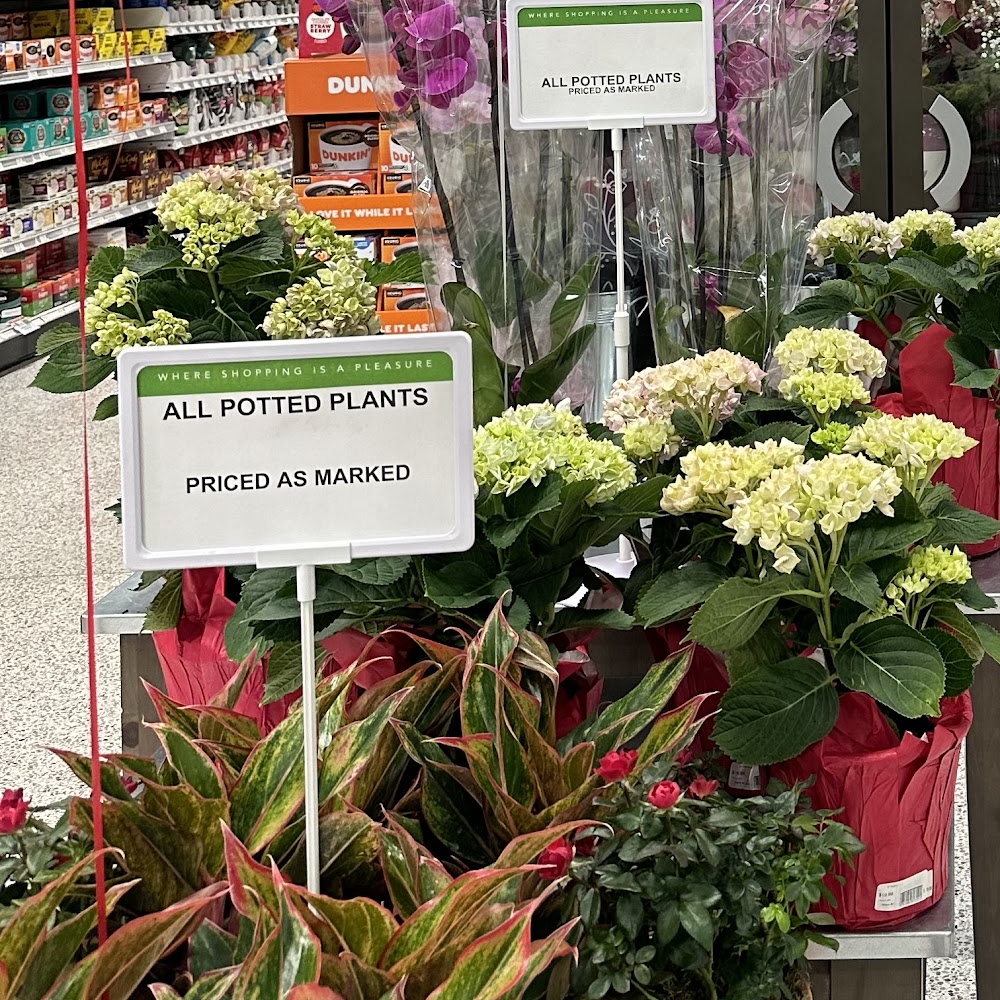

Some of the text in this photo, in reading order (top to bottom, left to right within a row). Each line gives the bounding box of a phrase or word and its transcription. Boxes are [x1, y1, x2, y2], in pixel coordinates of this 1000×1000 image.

[528, 11, 560, 19] WHERE
[565, 10, 614, 18] SHOPPING
[643, 7, 690, 15] PLEASURE
[327, 75, 375, 94] DUN
[541, 72, 681, 88] ALL POTTED PLANTS
[568, 84, 656, 95] PRICED AS MARKED
[322, 147, 371, 162] DUNKIN'
[340, 209, 352, 218] IT
[354, 208, 390, 217] WHILE
[392, 207, 404, 216] IT
[393, 324, 405, 333] IT
[157, 359, 434, 382] WHERE SHOPPING IS A PLEASURE
[162, 387, 430, 421] ALL POTTED PLANTS
[186, 464, 411, 494] PRICED AS MARKED
